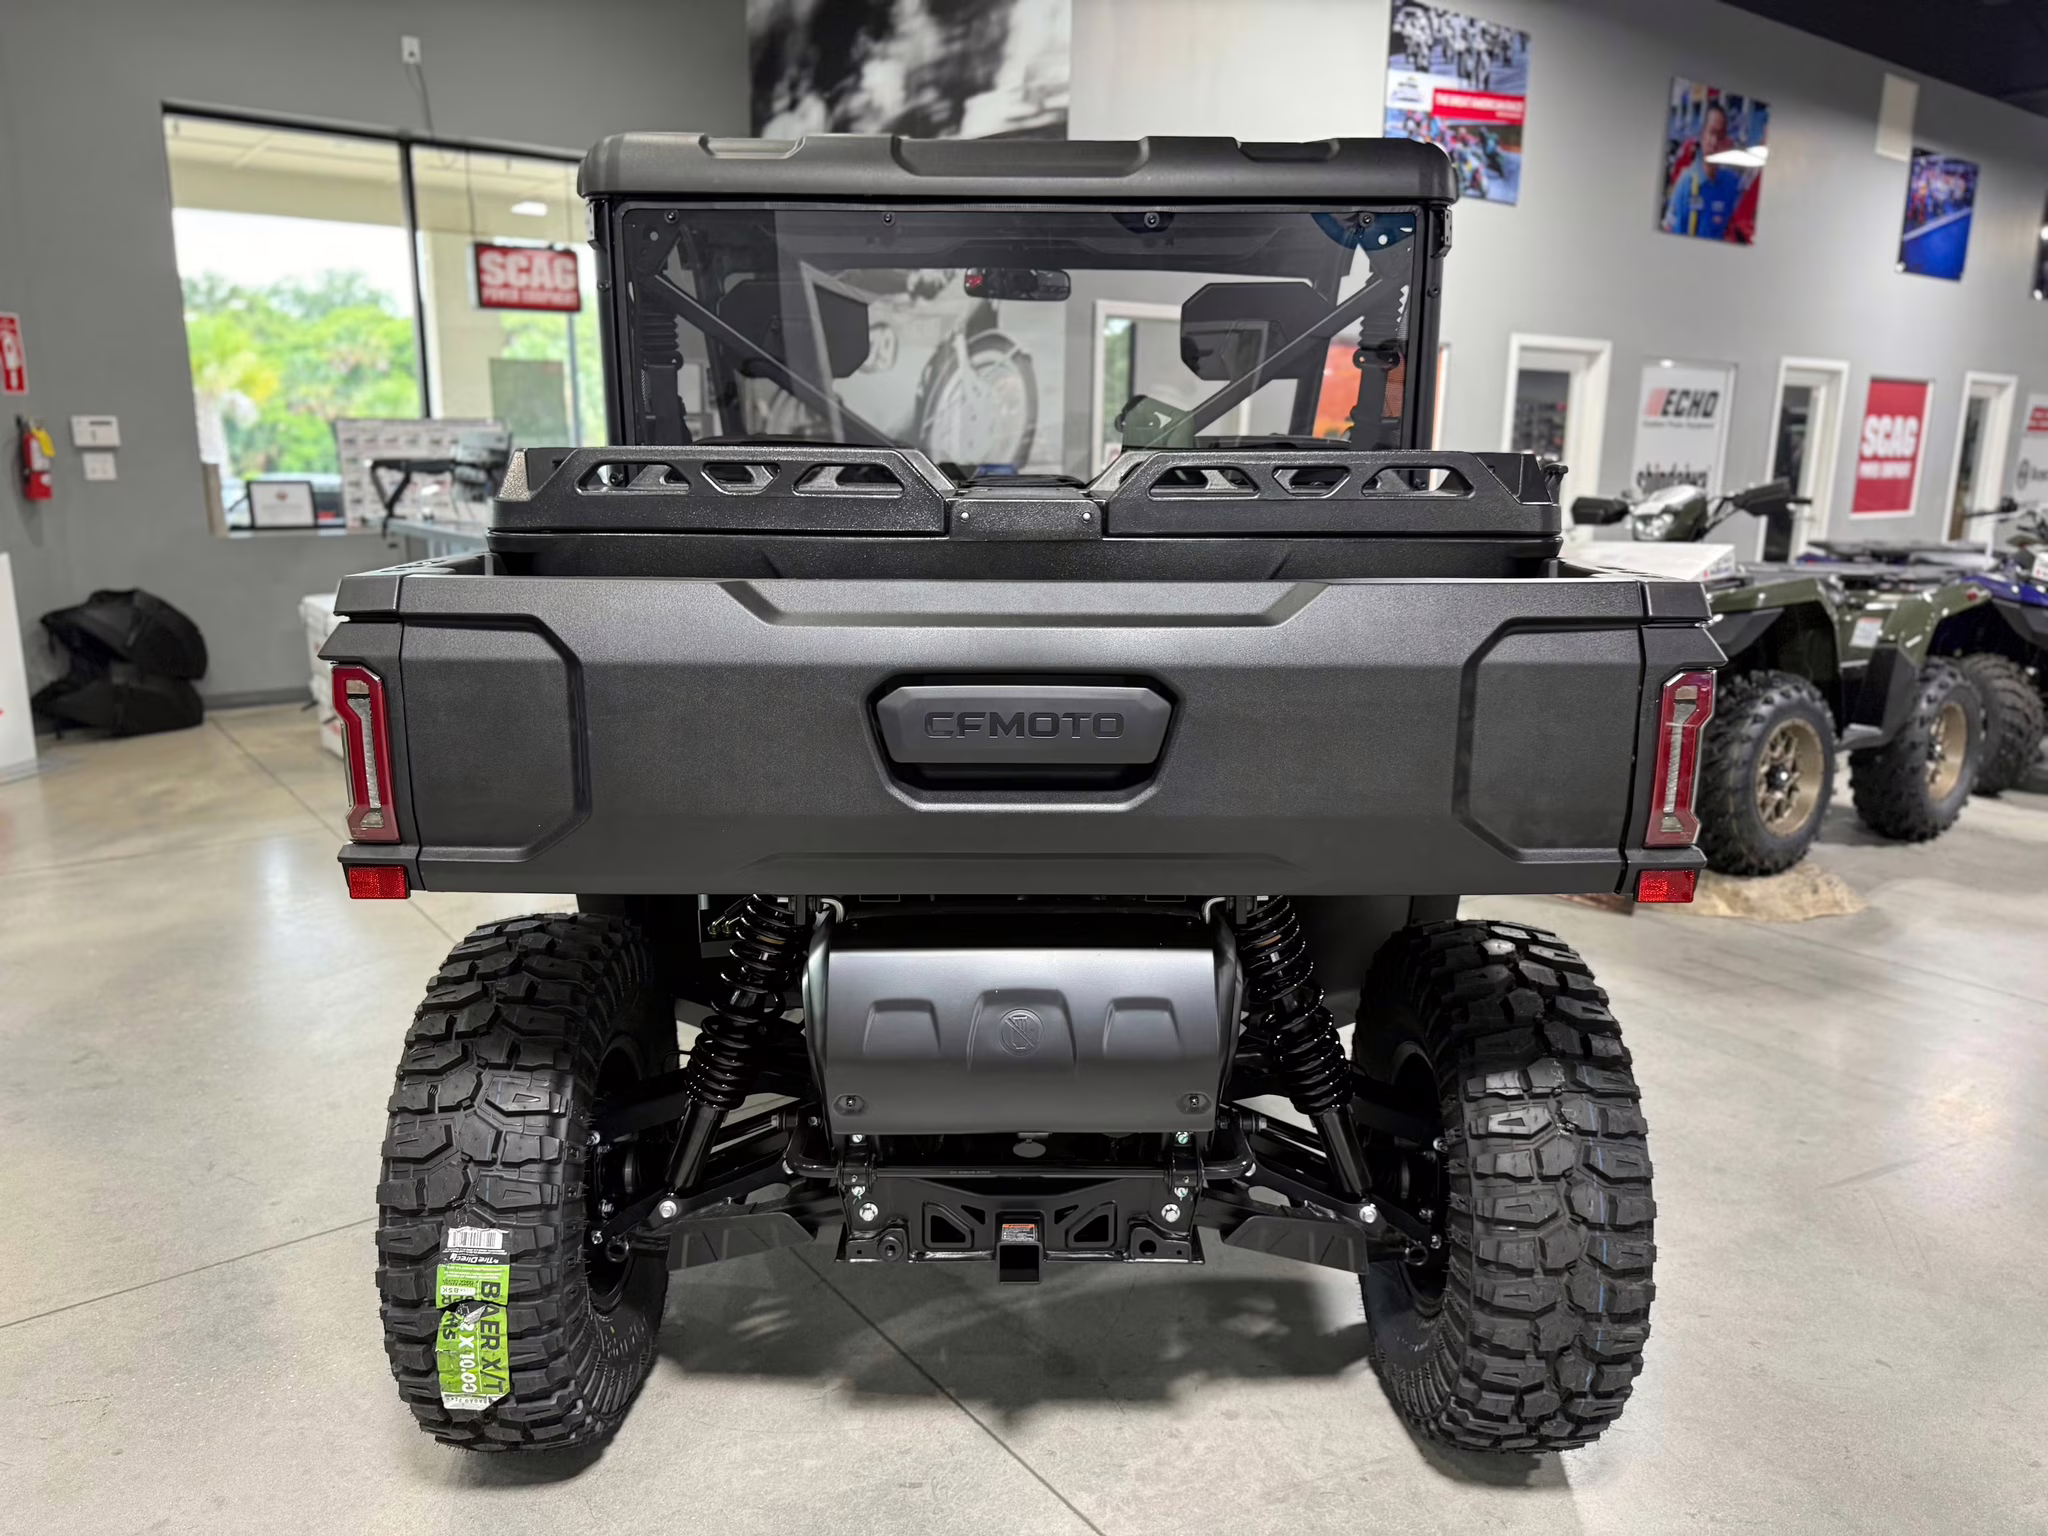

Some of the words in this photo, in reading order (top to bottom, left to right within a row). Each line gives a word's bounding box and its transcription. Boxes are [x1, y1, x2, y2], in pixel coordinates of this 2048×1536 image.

[480, 250, 577, 290] SCAG
[1661, 388, 1719, 418] ECHO
[1861, 414, 1919, 458] SCAG
[924, 711, 1125, 739] CFMOTO
